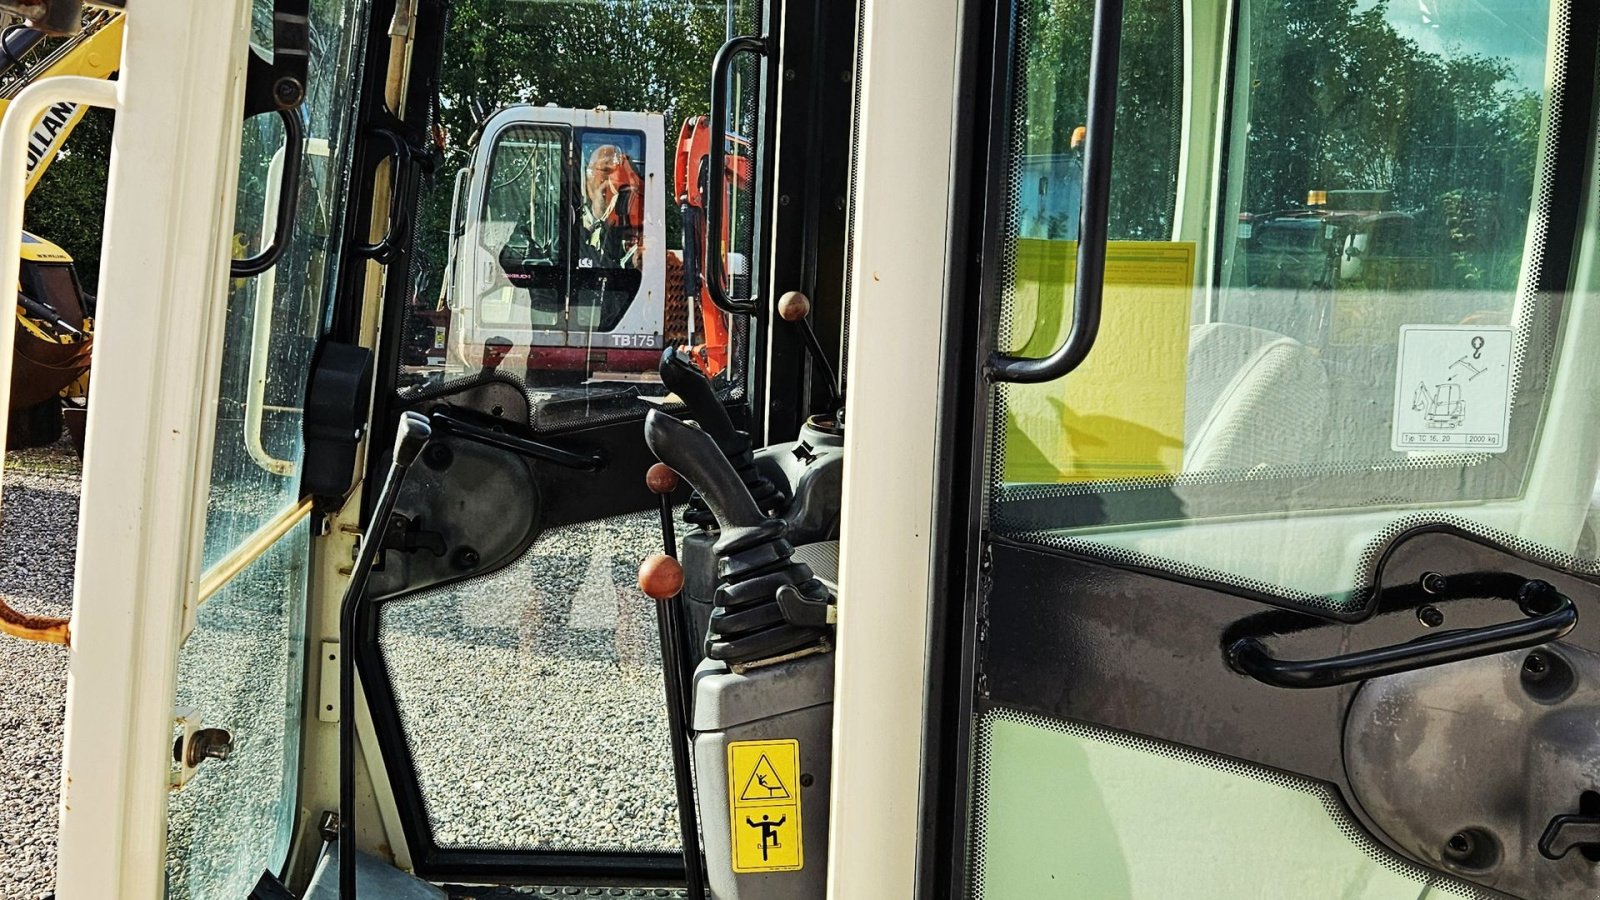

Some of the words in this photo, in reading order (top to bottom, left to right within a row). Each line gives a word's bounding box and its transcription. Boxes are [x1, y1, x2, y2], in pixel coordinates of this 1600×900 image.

[612, 334, 655, 347] TB175
[1418, 434, 1427, 442] TC
[1469, 435, 1486, 443] 2000
[1488, 436, 1496, 444] kg
